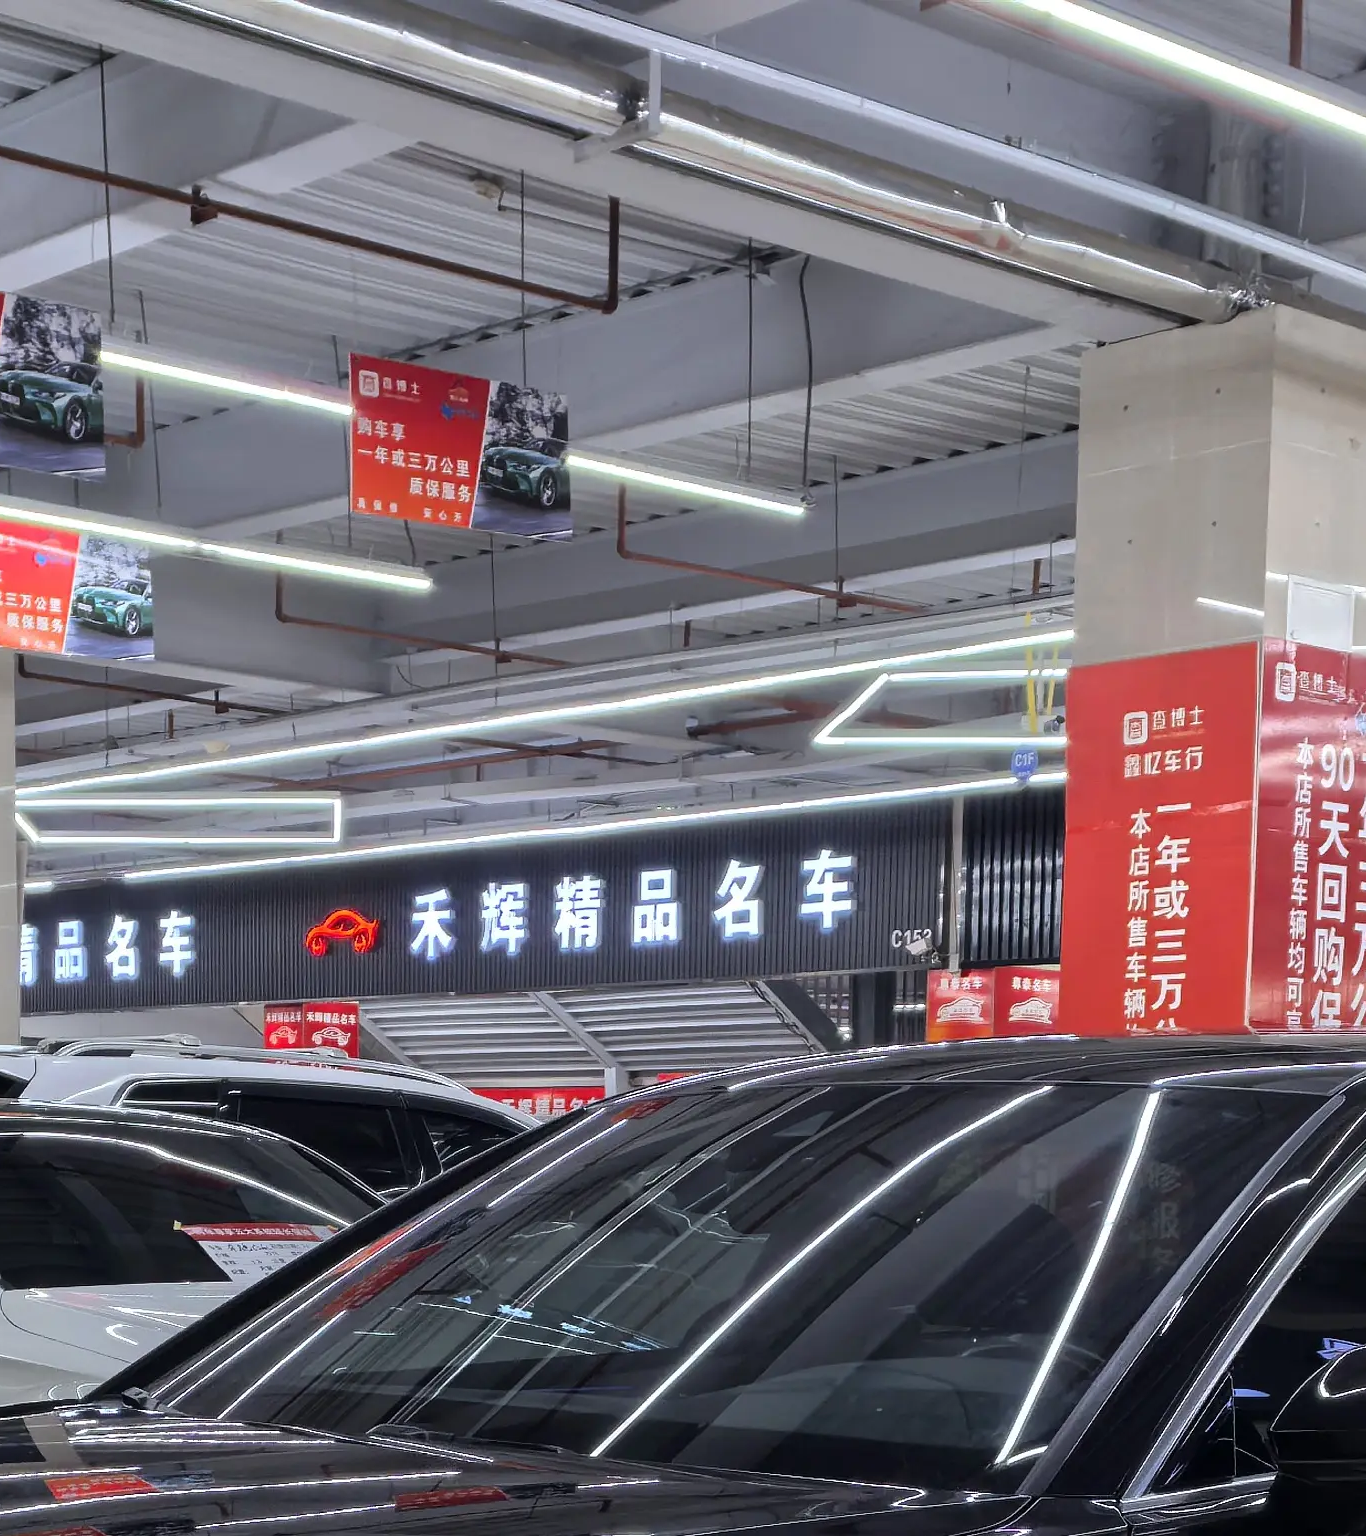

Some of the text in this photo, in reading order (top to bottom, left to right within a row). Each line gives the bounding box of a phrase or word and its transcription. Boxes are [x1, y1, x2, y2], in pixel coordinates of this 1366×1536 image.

[357, 417, 406, 442] 购车享
[357, 445, 471, 478] 一年或三万公里
[409, 477, 472, 503] 质保服务
[6, 612, 65, 634] 质保服务
[1151, 705, 1205, 731] 查博士
[1016, 752, 1035, 767] C1F
[1123, 746, 1204, 779] 鑫忆车行
[1310, 743, 1355, 1028] 90天回购保
[410, 849, 858, 958] 禾辉精品名车
[1123, 808, 1152, 1030] 本店所售车辆
